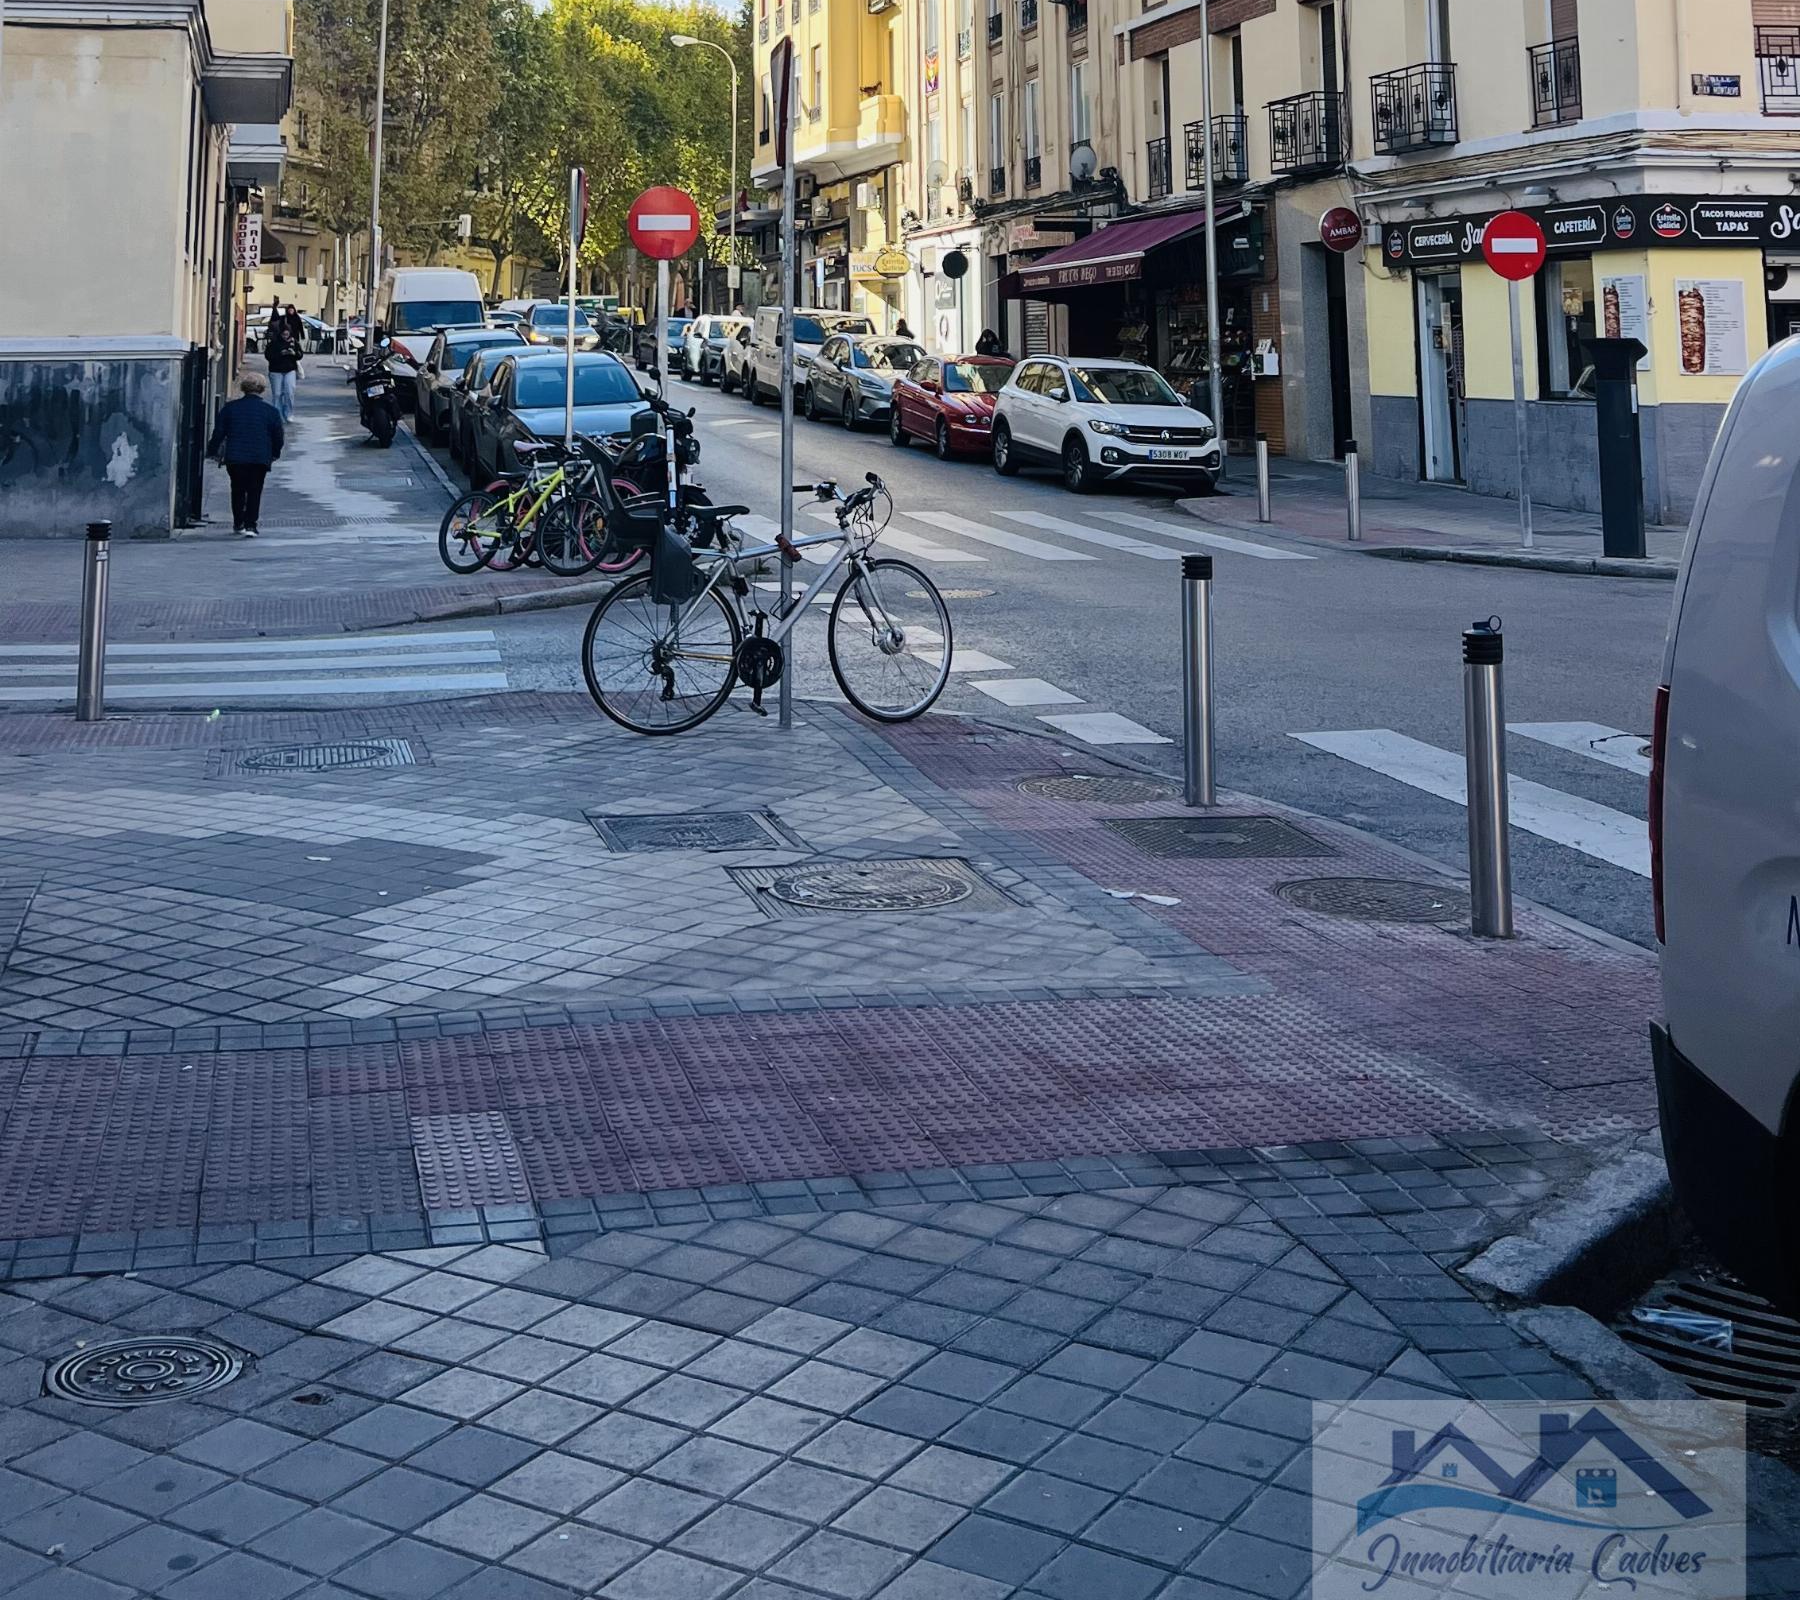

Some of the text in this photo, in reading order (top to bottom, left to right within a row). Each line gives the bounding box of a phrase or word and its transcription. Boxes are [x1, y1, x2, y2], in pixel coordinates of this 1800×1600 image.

[1700, 210, 1764, 218] TACOS FRANCESES
[1554, 215, 1597, 234] CAFETERÍA
[1716, 221, 1749, 232] TAPAS
[1329, 225, 1357, 238] AMBAR
[1414, 230, 1453, 248] CERVECERÍA
